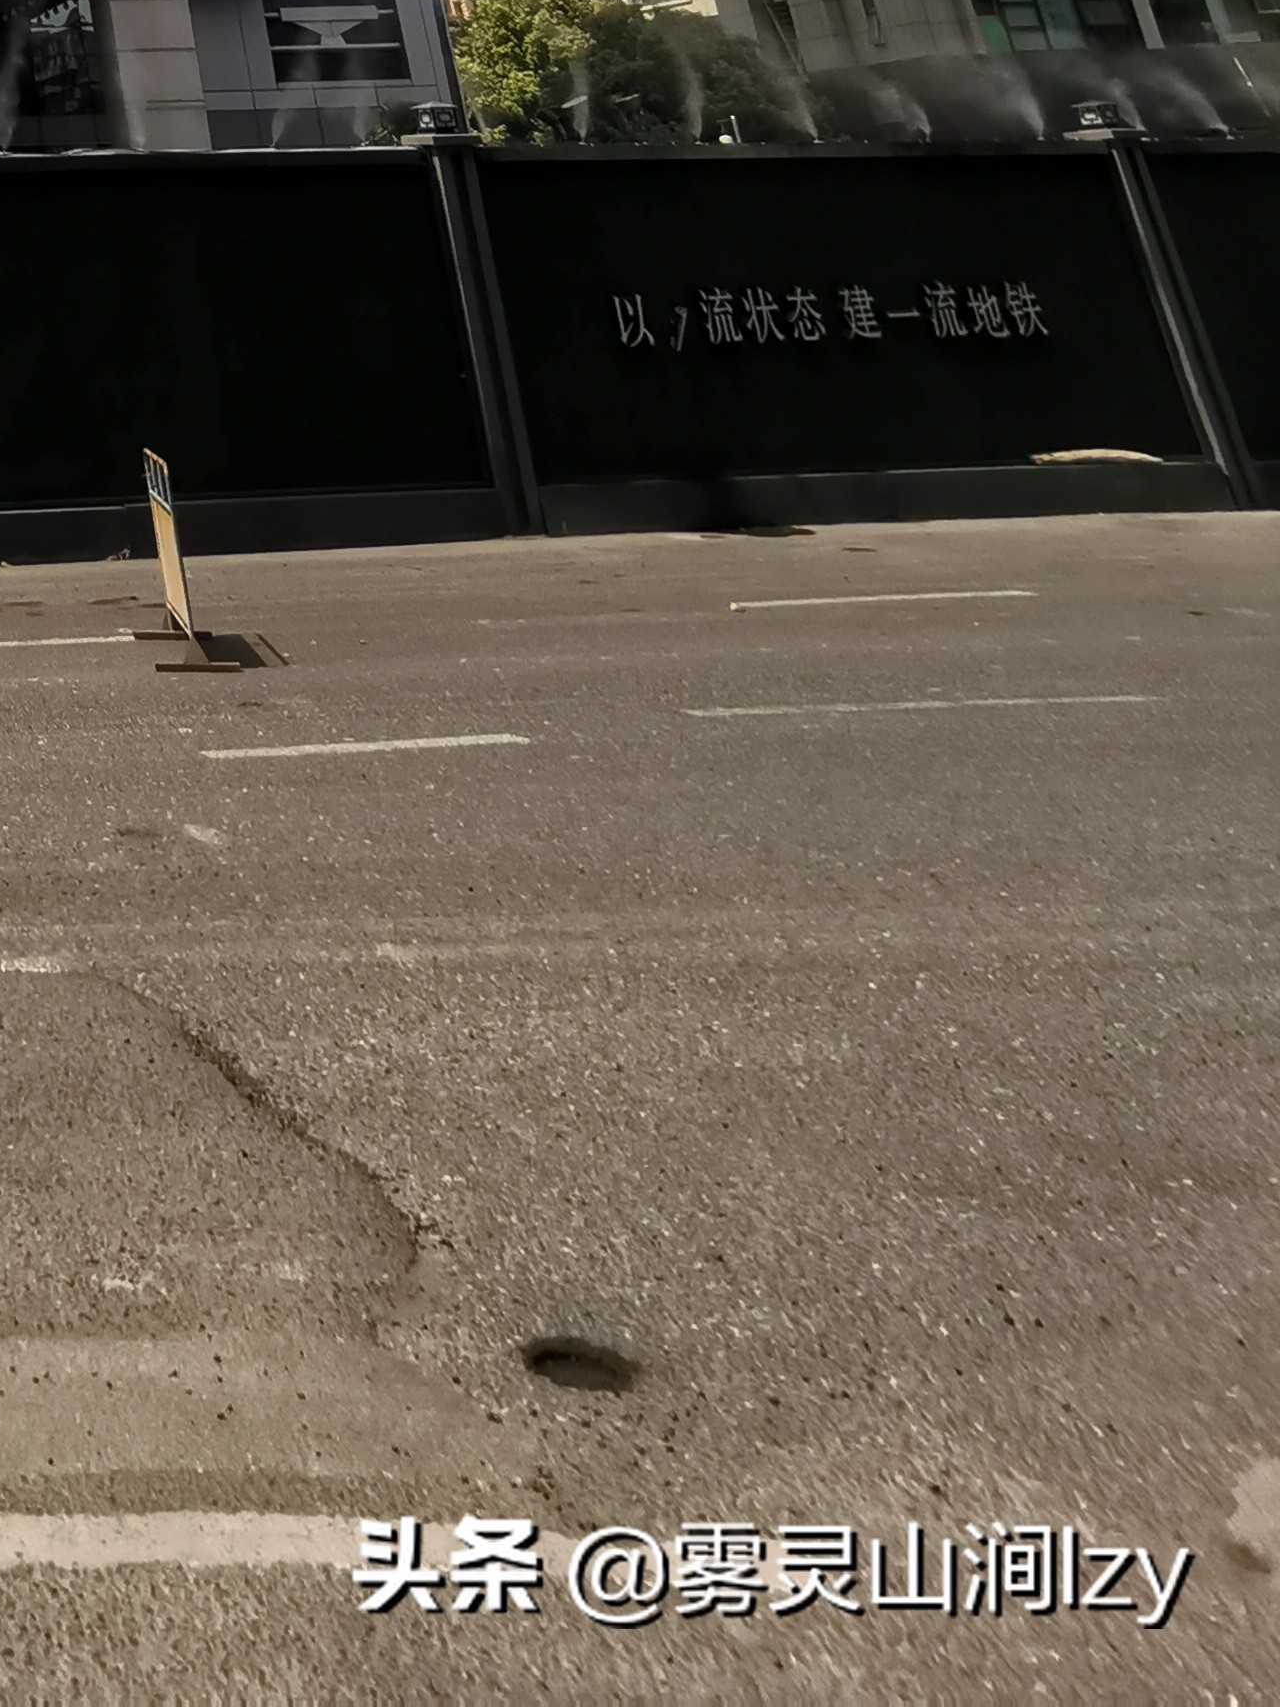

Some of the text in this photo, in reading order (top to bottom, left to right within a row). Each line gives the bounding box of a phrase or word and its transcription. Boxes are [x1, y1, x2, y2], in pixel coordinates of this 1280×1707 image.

[838, 278, 1050, 340] 建一流地铁
